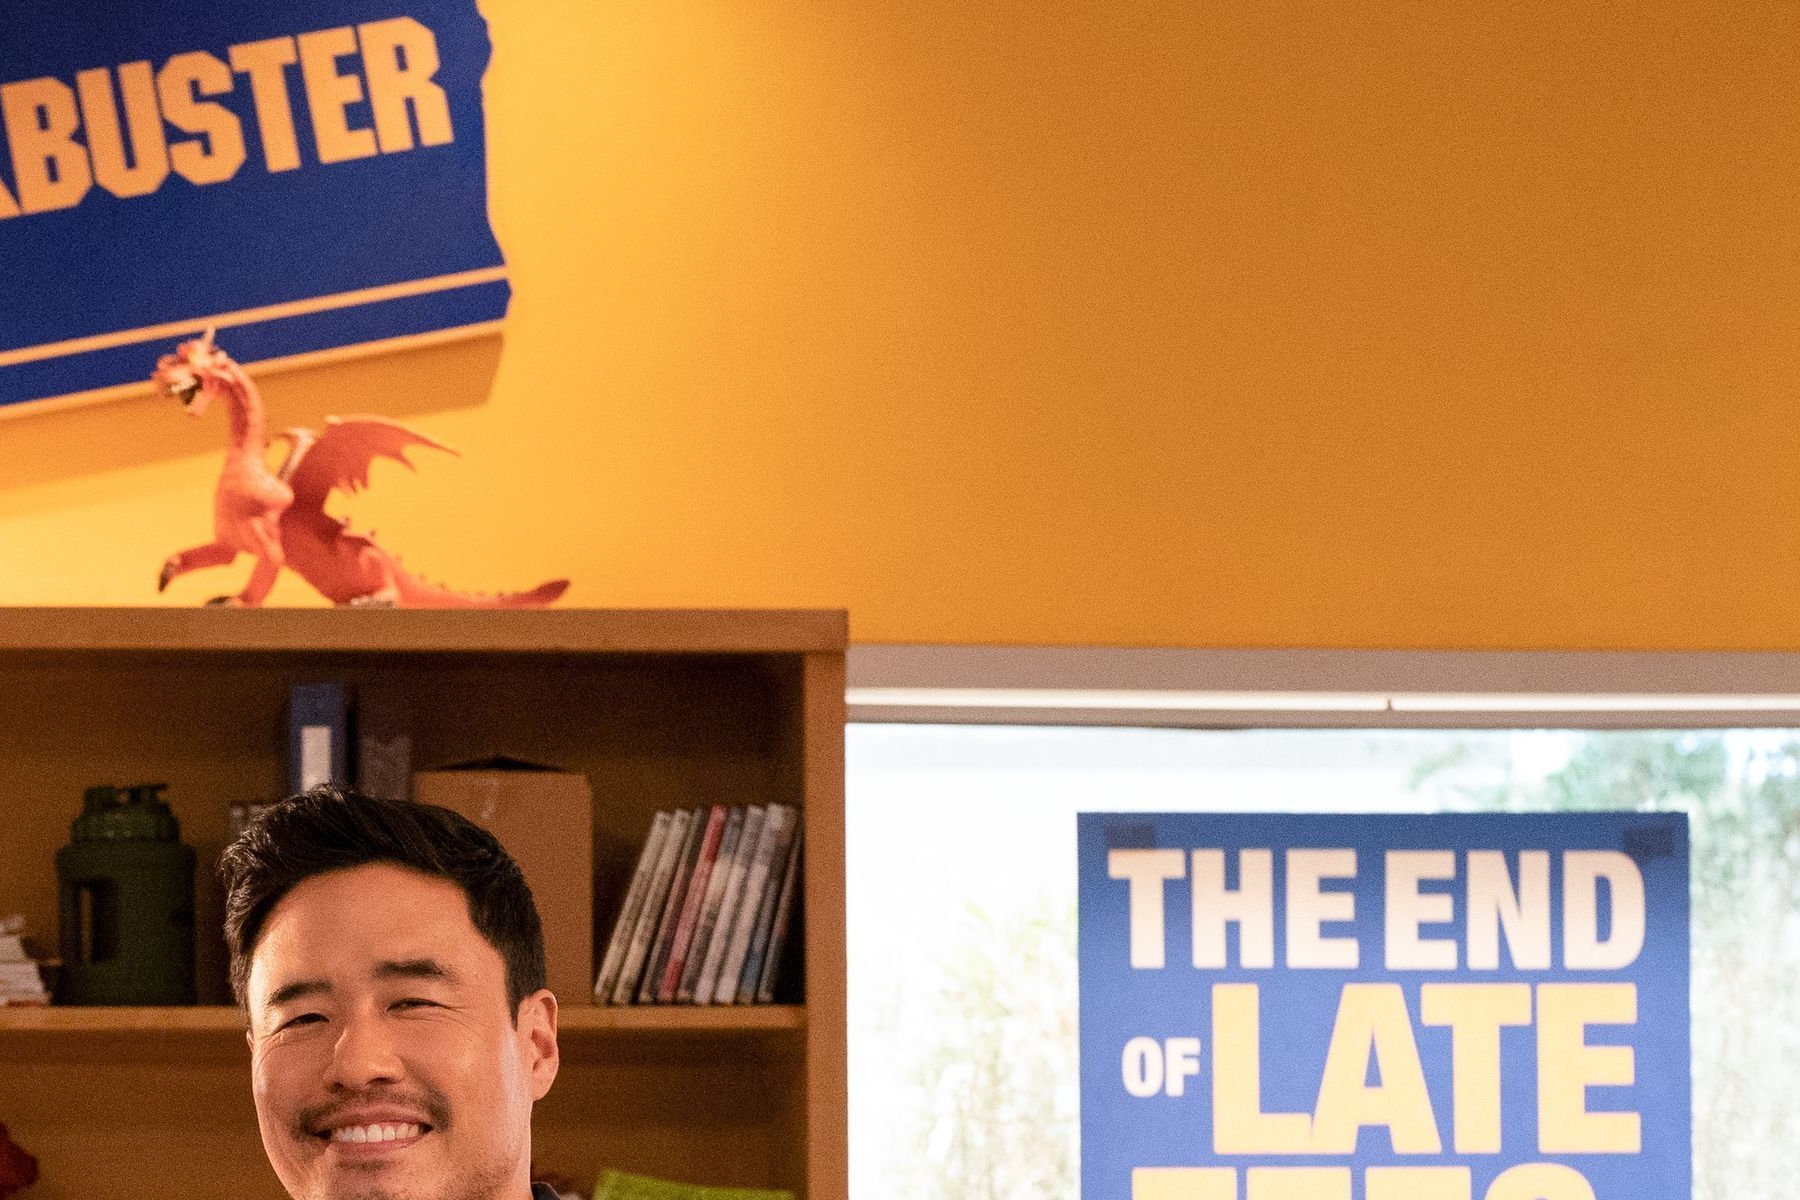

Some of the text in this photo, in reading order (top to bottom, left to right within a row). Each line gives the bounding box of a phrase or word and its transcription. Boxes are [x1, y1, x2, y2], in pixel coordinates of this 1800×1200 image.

[1107, 849, 1646, 970] THE END
[1122, 983, 1641, 1154] OF LATE
